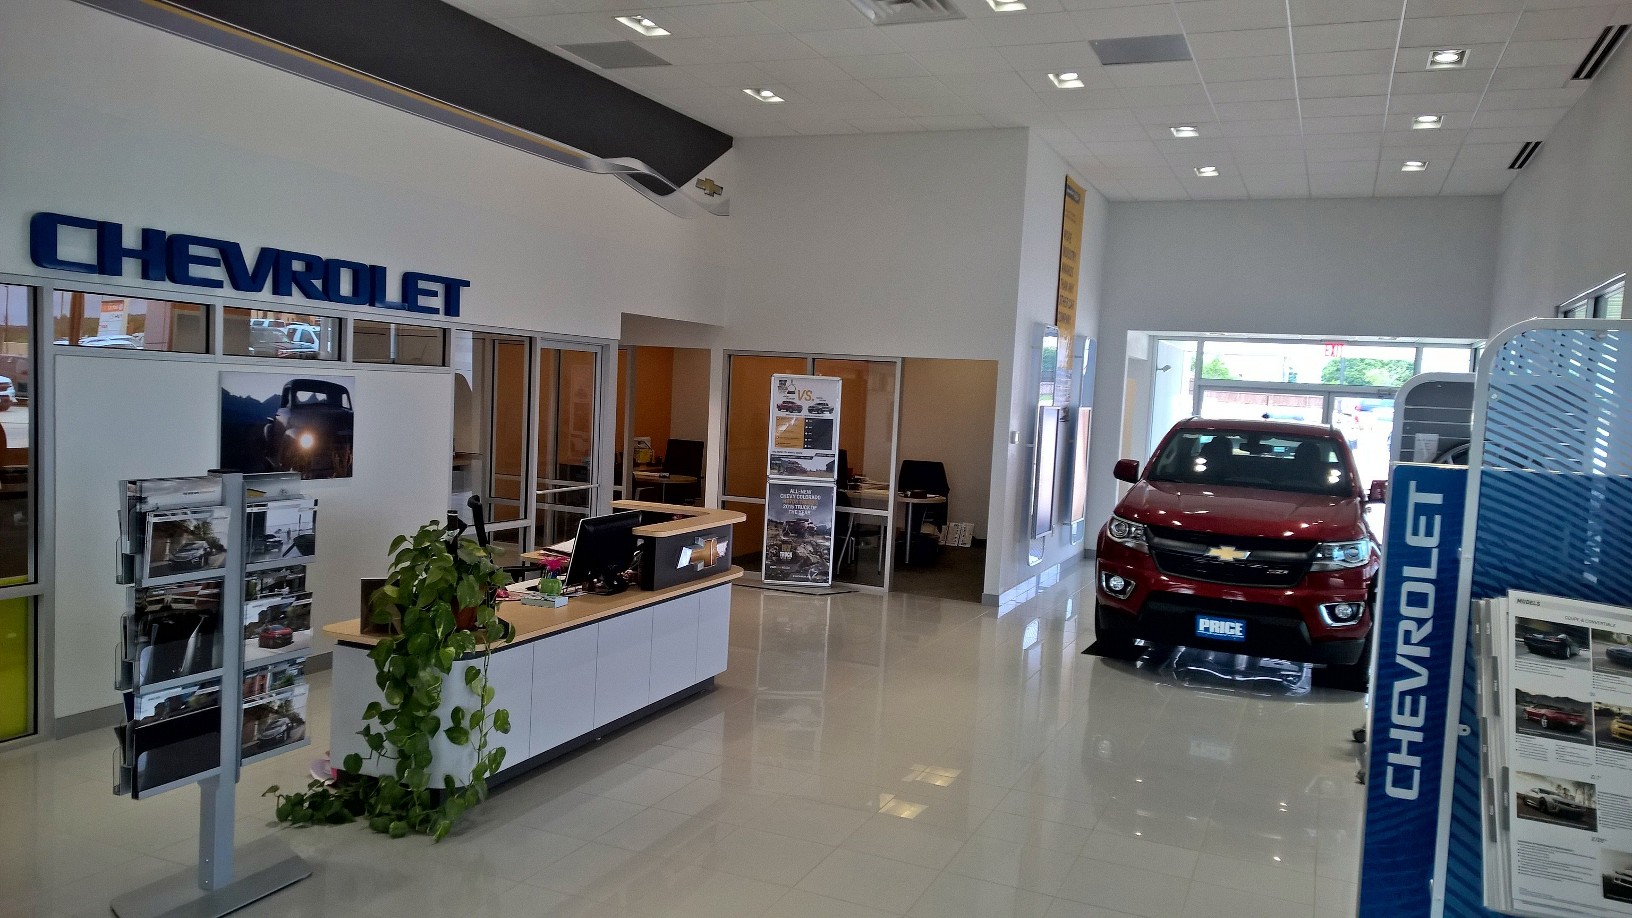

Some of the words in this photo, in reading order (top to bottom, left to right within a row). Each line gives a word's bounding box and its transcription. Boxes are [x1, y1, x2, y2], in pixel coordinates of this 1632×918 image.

[30, 211, 470, 317] CHEVROLET
[1325, 341, 1344, 357] EXIT
[797, 390, 815, 402] VS.
[1517, 598, 1541, 607] MODELS
[1199, 618, 1244, 636] PRICE
[1385, 480, 1444, 801] CHEVROLET
